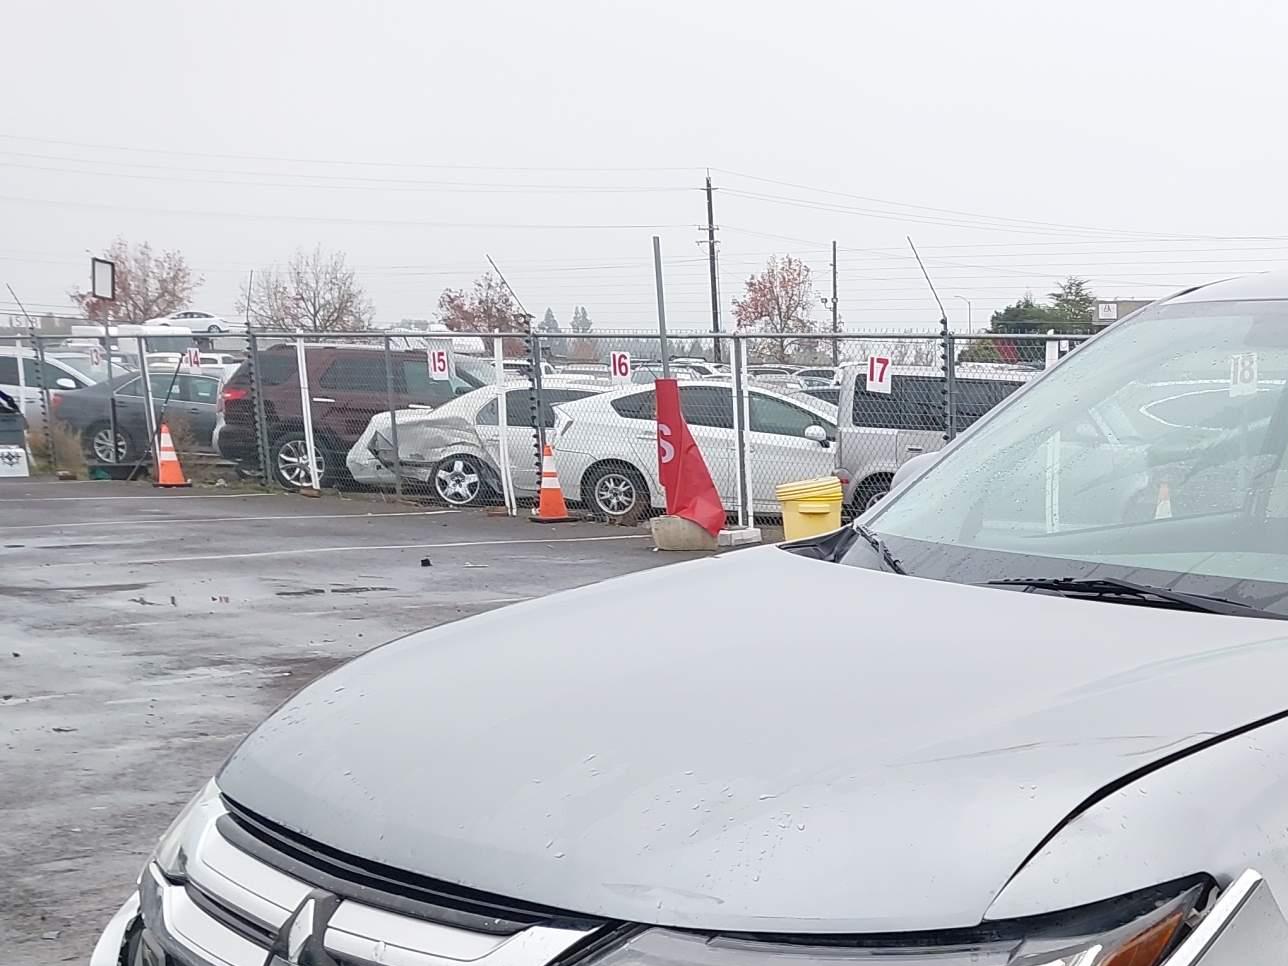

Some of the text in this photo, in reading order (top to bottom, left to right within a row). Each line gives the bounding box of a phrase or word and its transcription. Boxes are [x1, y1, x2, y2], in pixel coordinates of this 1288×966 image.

[188, 349, 200, 368] 14
[432, 351, 446, 372] 15
[612, 353, 628, 376] 16
[869, 356, 889, 383] 17
[1232, 356, 1255, 385] 18
